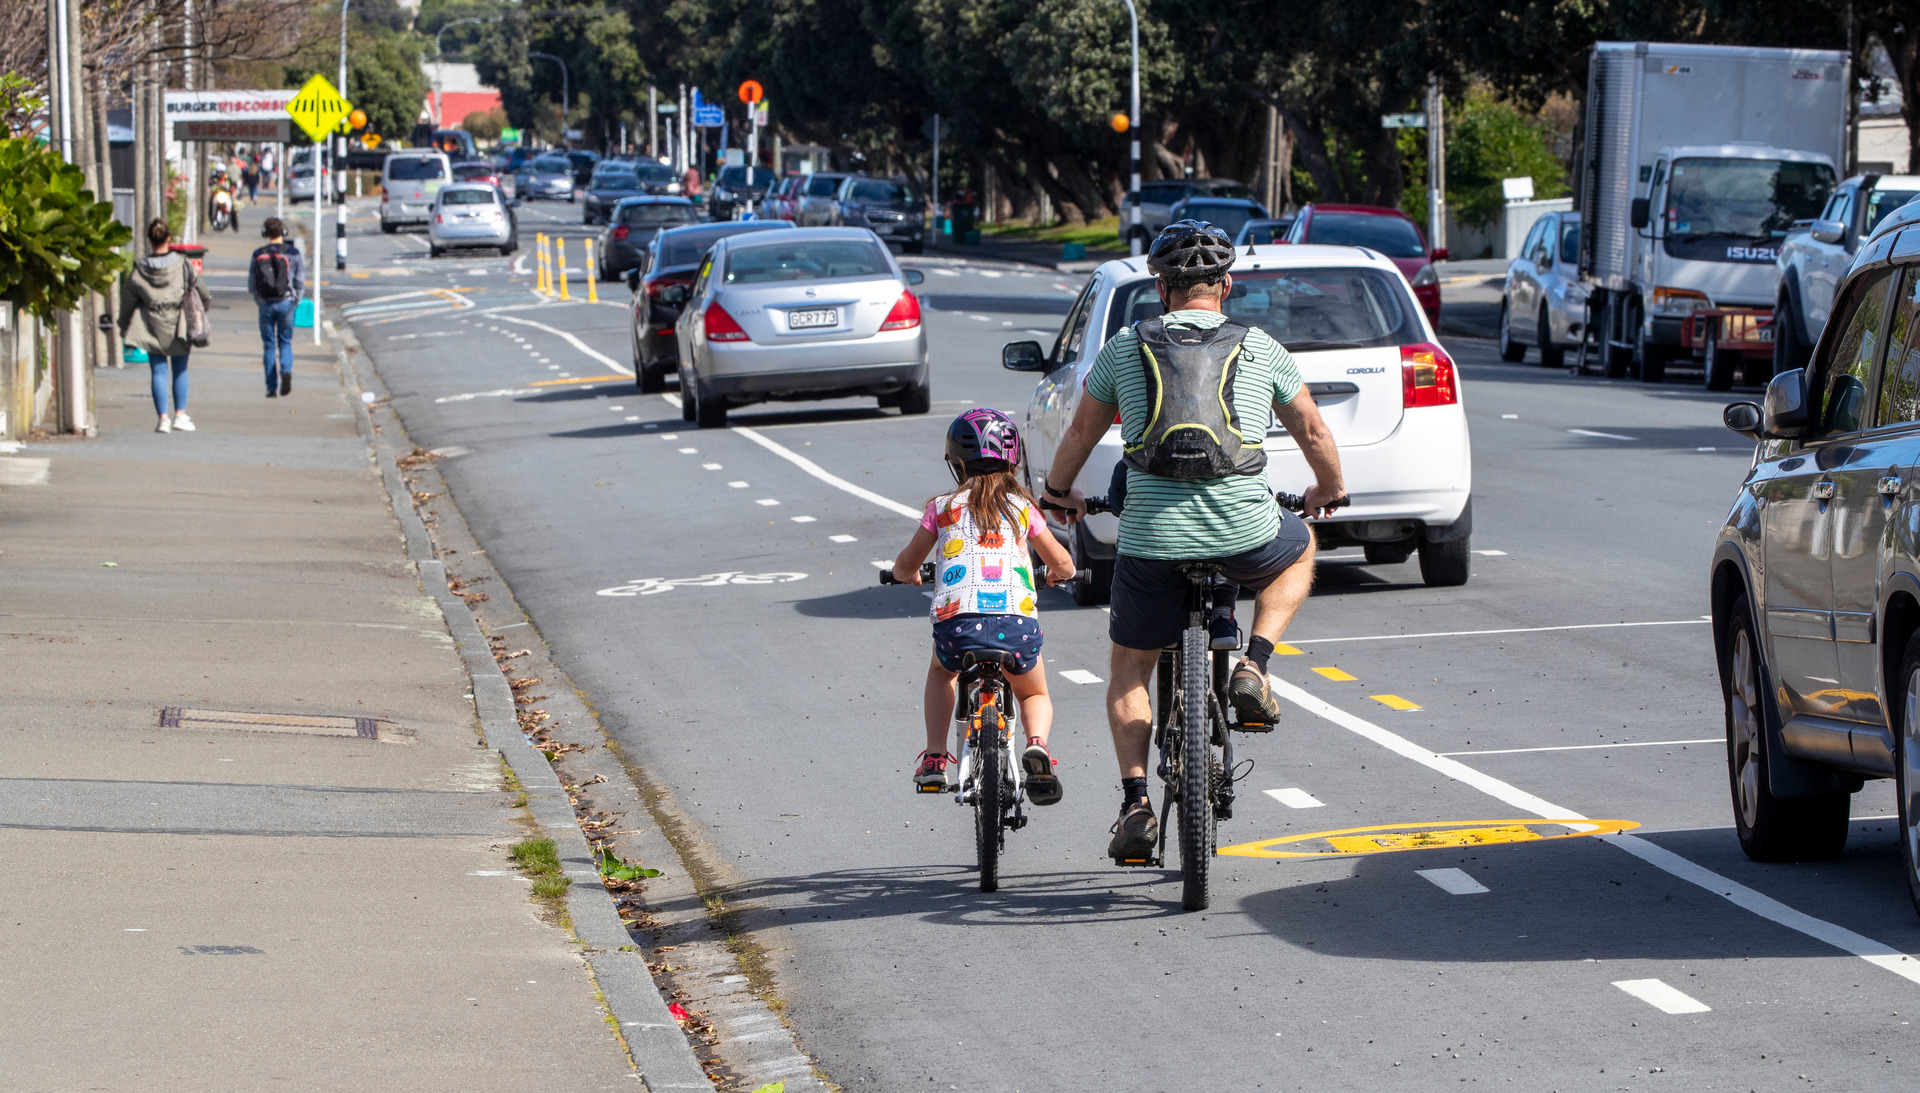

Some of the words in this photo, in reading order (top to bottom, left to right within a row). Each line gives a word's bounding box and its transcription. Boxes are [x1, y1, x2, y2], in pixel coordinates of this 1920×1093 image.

[187, 122, 279, 137] WISCONSIN
[791, 311, 836, 326] GCR773
[982, 537, 1001, 545] YAY
[945, 567, 962, 583] OK
